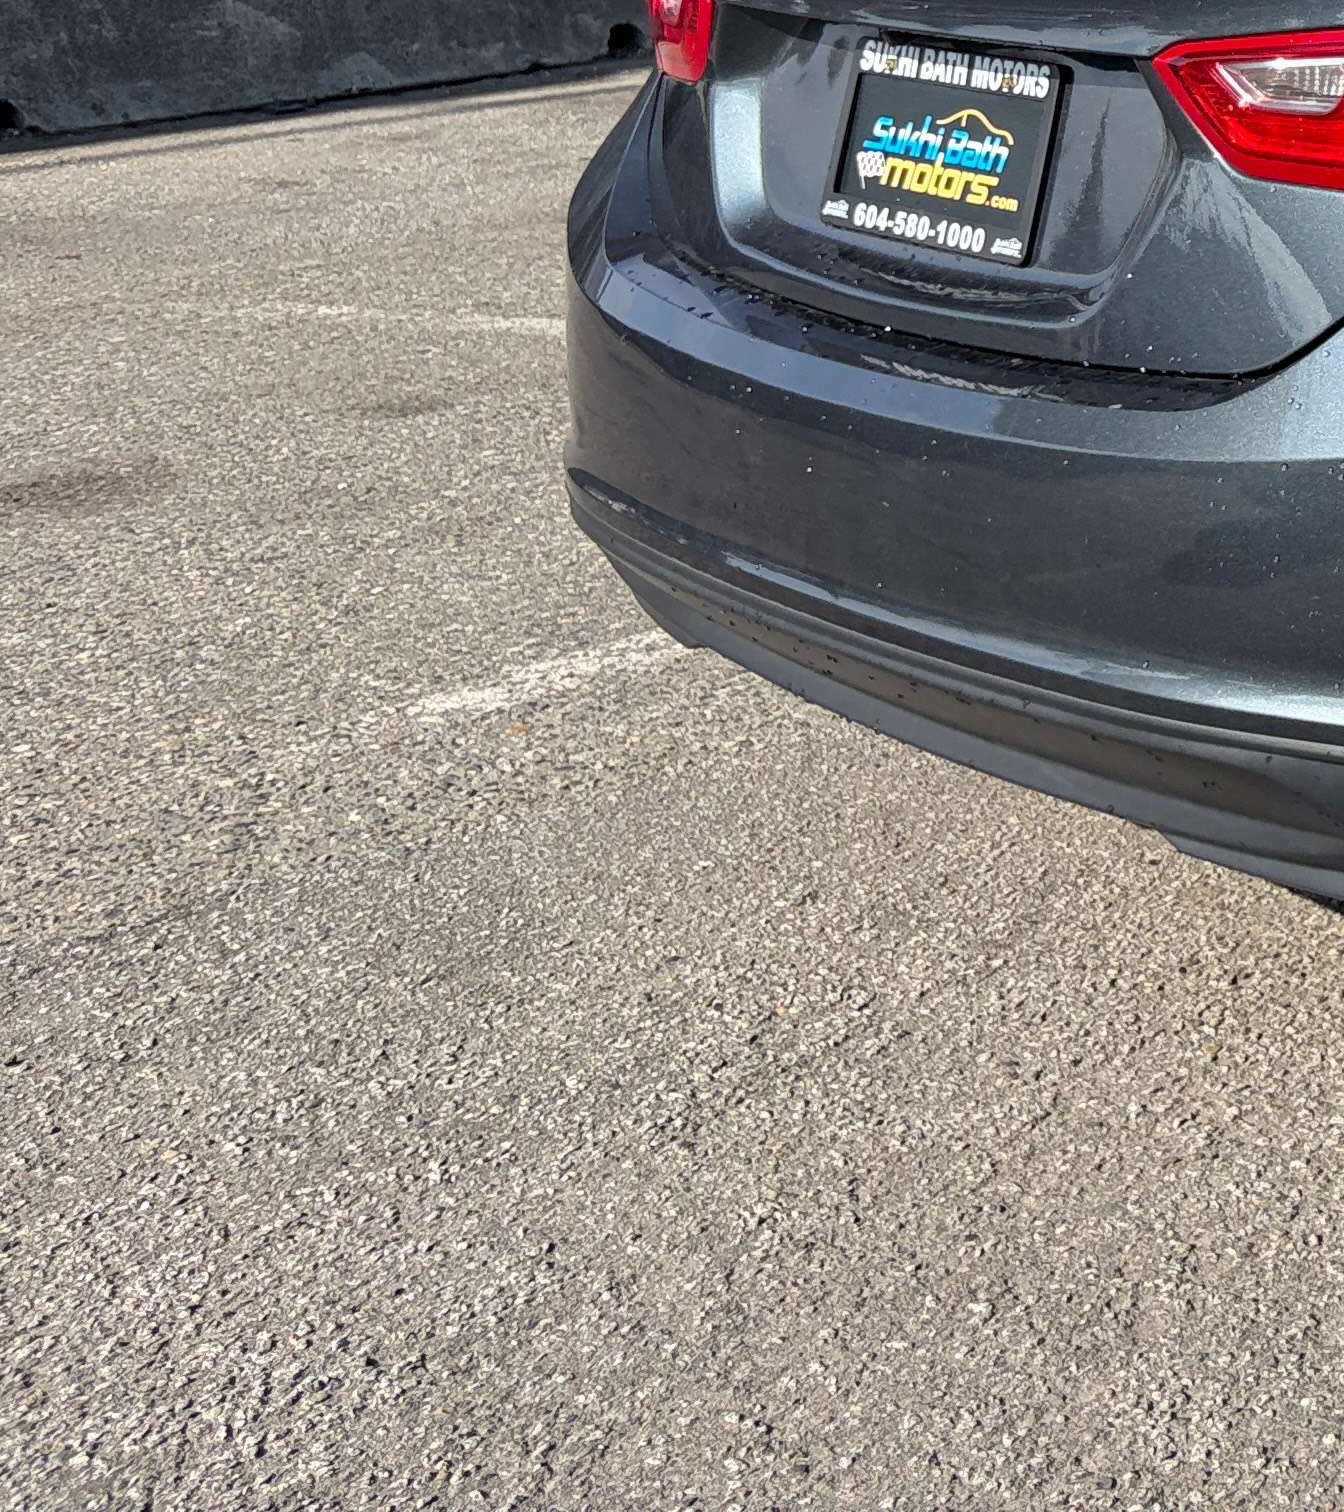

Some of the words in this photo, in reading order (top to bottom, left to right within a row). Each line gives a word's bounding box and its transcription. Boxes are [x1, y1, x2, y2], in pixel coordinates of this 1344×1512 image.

[859, 39, 921, 79] SUKHI
[919, 48, 970, 87] BATH
[971, 55, 1051, 100] MOTORS
[862, 115, 946, 161] Sukhi
[943, 128, 1010, 174] Bath
[853, 202, 986, 253] 604-580-1000
